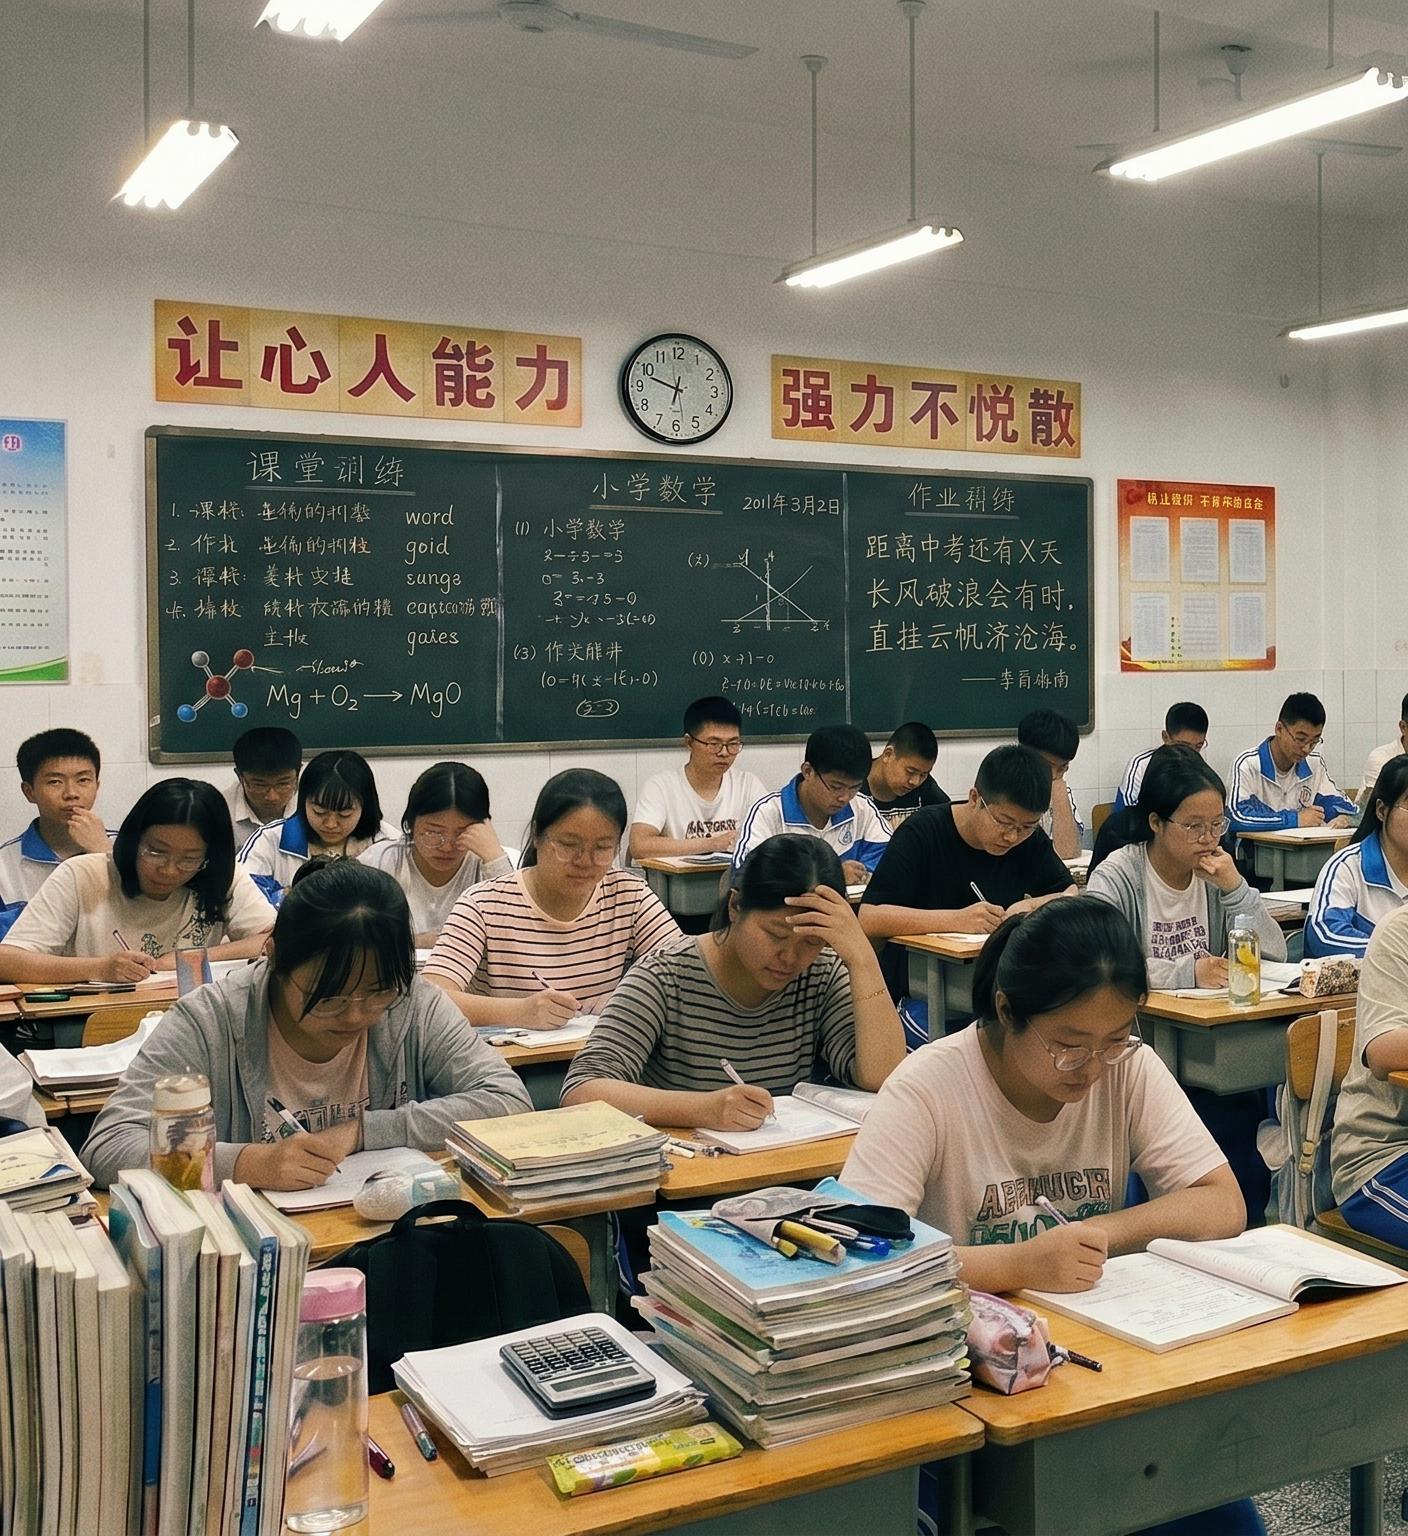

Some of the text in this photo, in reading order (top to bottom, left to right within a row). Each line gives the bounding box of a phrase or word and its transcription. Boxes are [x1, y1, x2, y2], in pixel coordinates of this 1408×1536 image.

[656, 350, 665, 363] 11
[672, 347, 685, 360] 12
[167, 315, 570, 410] 让心人能力
[641, 362, 654, 376] 10
[706, 368, 714, 381] 2
[636, 379, 644, 392] 9
[710, 386, 719, 398] 3
[641, 398, 648, 411] 8
[705, 403, 712, 416] 4
[782, 367, 1076, 448] 强力不悦散
[656, 413, 663, 426] 7
[672, 419, 680, 432] 6
[691, 415, 700, 429] 5
[592, 473, 717, 506] 小学数学
[405, 504, 455, 526] word
[543, 518, 625, 541] 小学数学
[866, 532, 1063, 566] 距离中考还有X天
[266, 684, 302, 720] Mg
[410, 681, 462, 718] MgO
